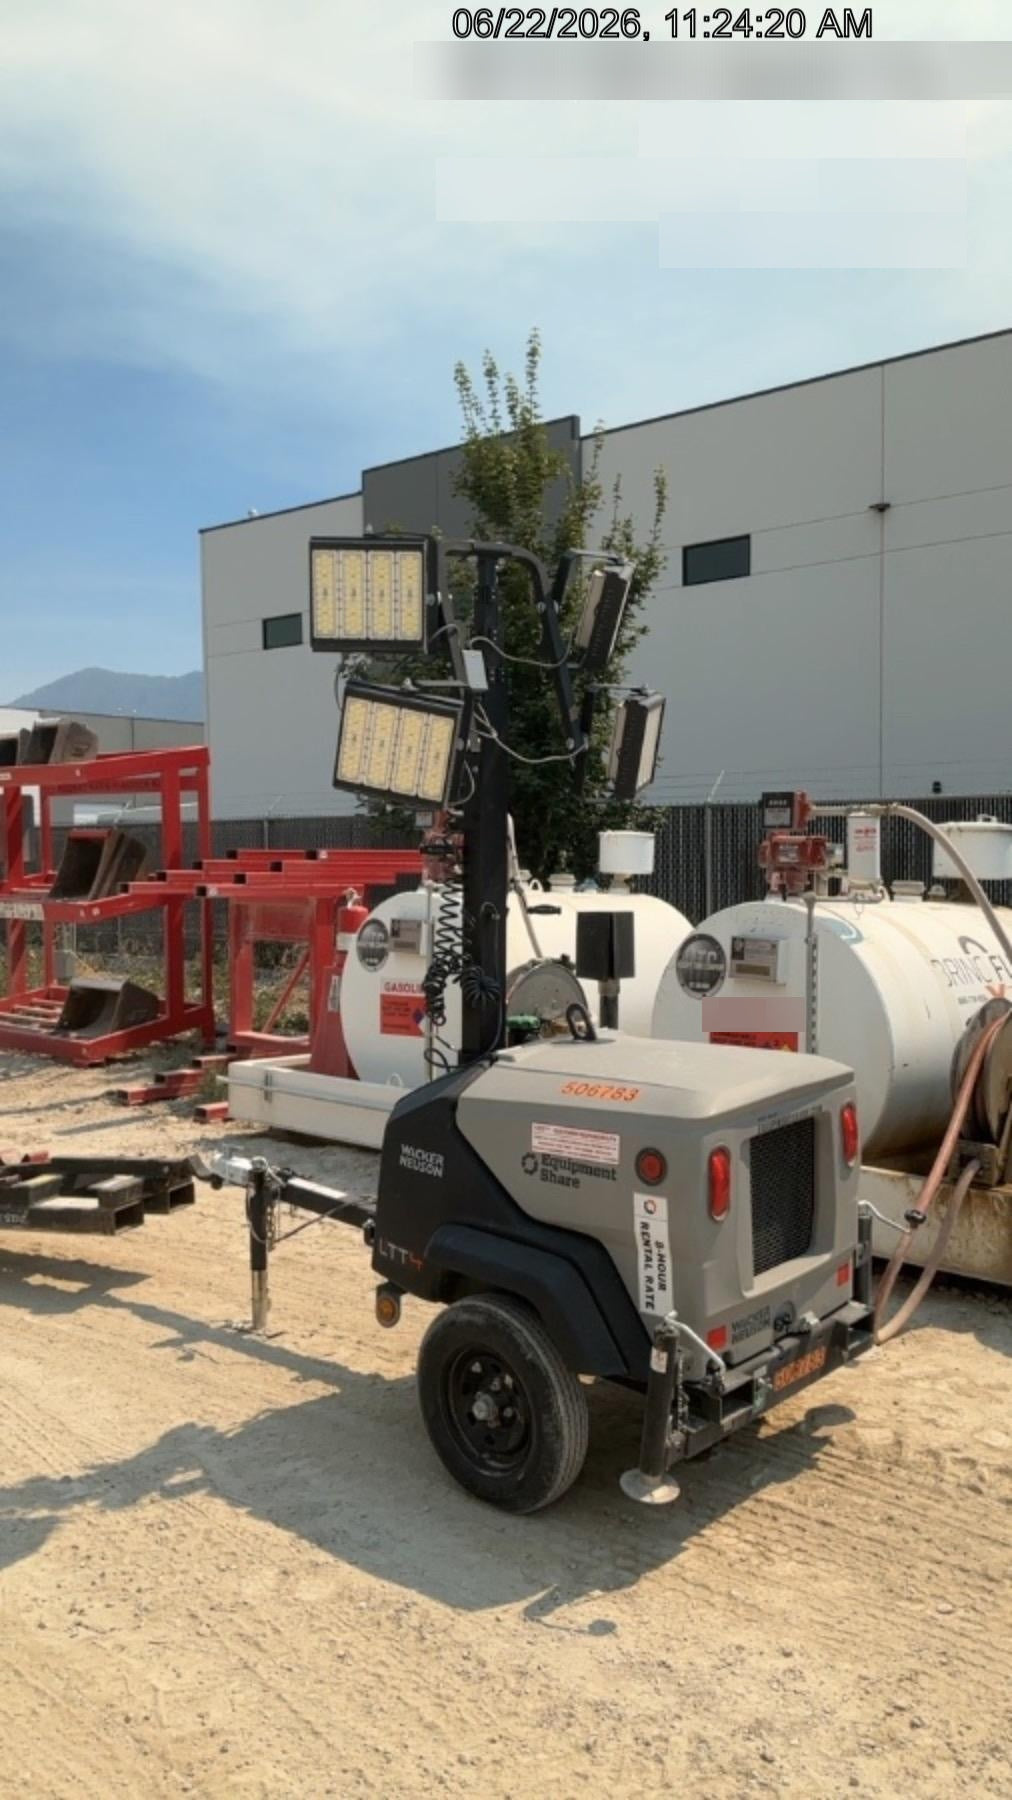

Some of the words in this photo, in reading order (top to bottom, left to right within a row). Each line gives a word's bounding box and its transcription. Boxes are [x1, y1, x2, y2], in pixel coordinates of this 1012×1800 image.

[384, 981, 424, 993] GASOLI
[561, 1081, 639, 1102] 506783
[399, 1154, 443, 1178] NEUSON
[401, 1143, 444, 1166] WACKER
[540, 1168, 580, 1189] Share
[541, 1152, 617, 1182] Equipment
[379, 1236, 424, 1271] LTT4
[641, 1221, 653, 1270] RENTAL
[645, 1275, 655, 1310] RATE
